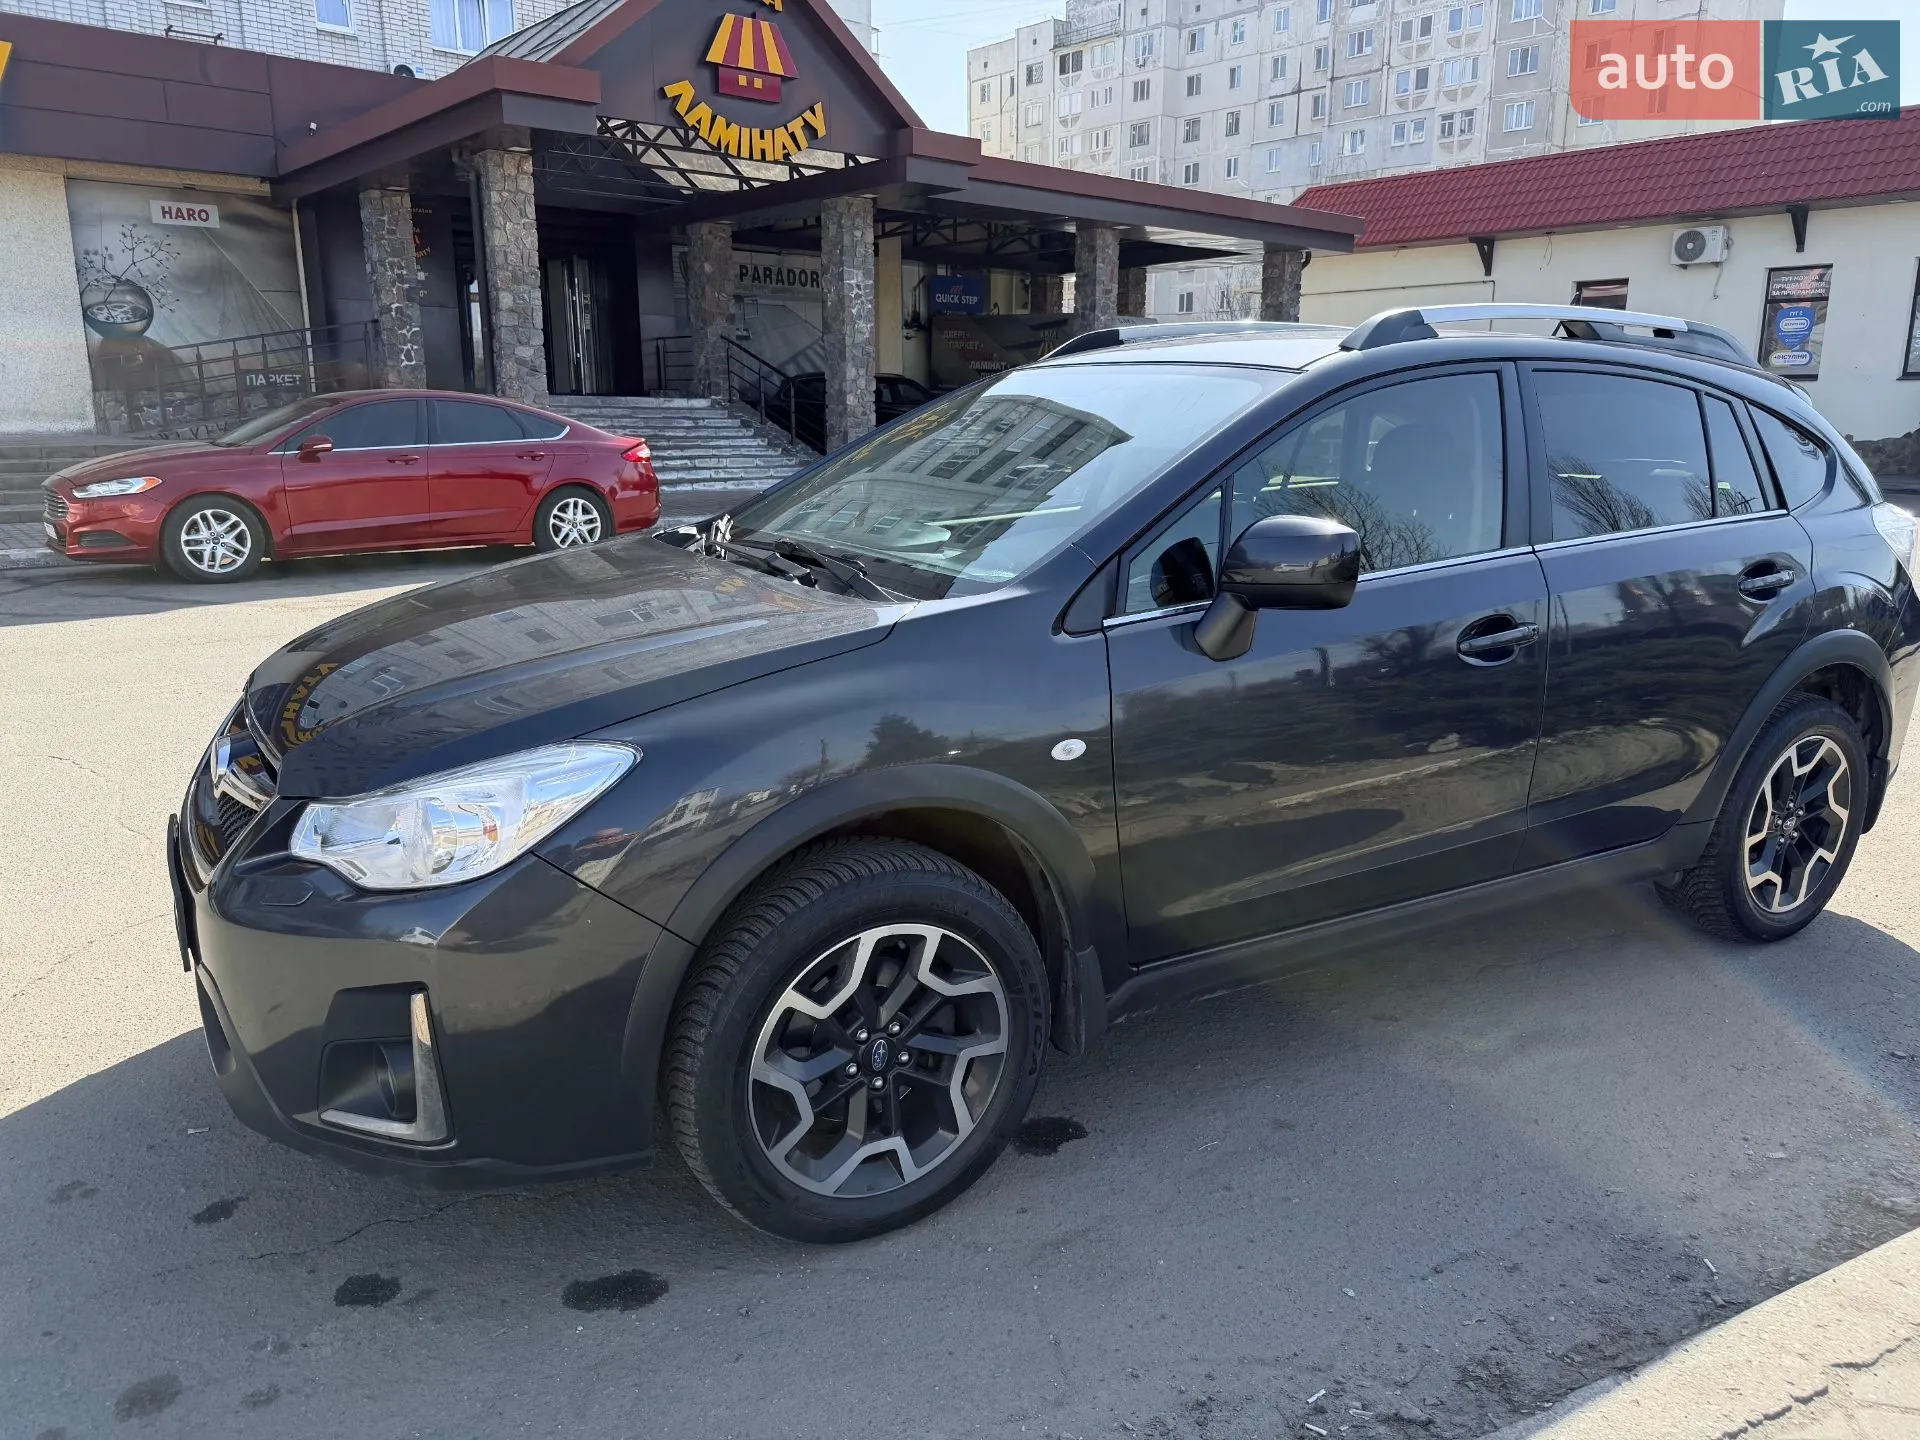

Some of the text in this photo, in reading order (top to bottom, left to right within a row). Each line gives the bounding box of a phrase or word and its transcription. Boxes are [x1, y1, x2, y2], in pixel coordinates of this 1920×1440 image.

[663, 80, 827, 161] ЛАМІНАТУ
[161, 205, 210, 222] HARO
[739, 264, 820, 288] PARADOR
[935, 293, 978, 305] QUICK STEP
[970, 361, 1007, 371] ЛАМІНАТ
